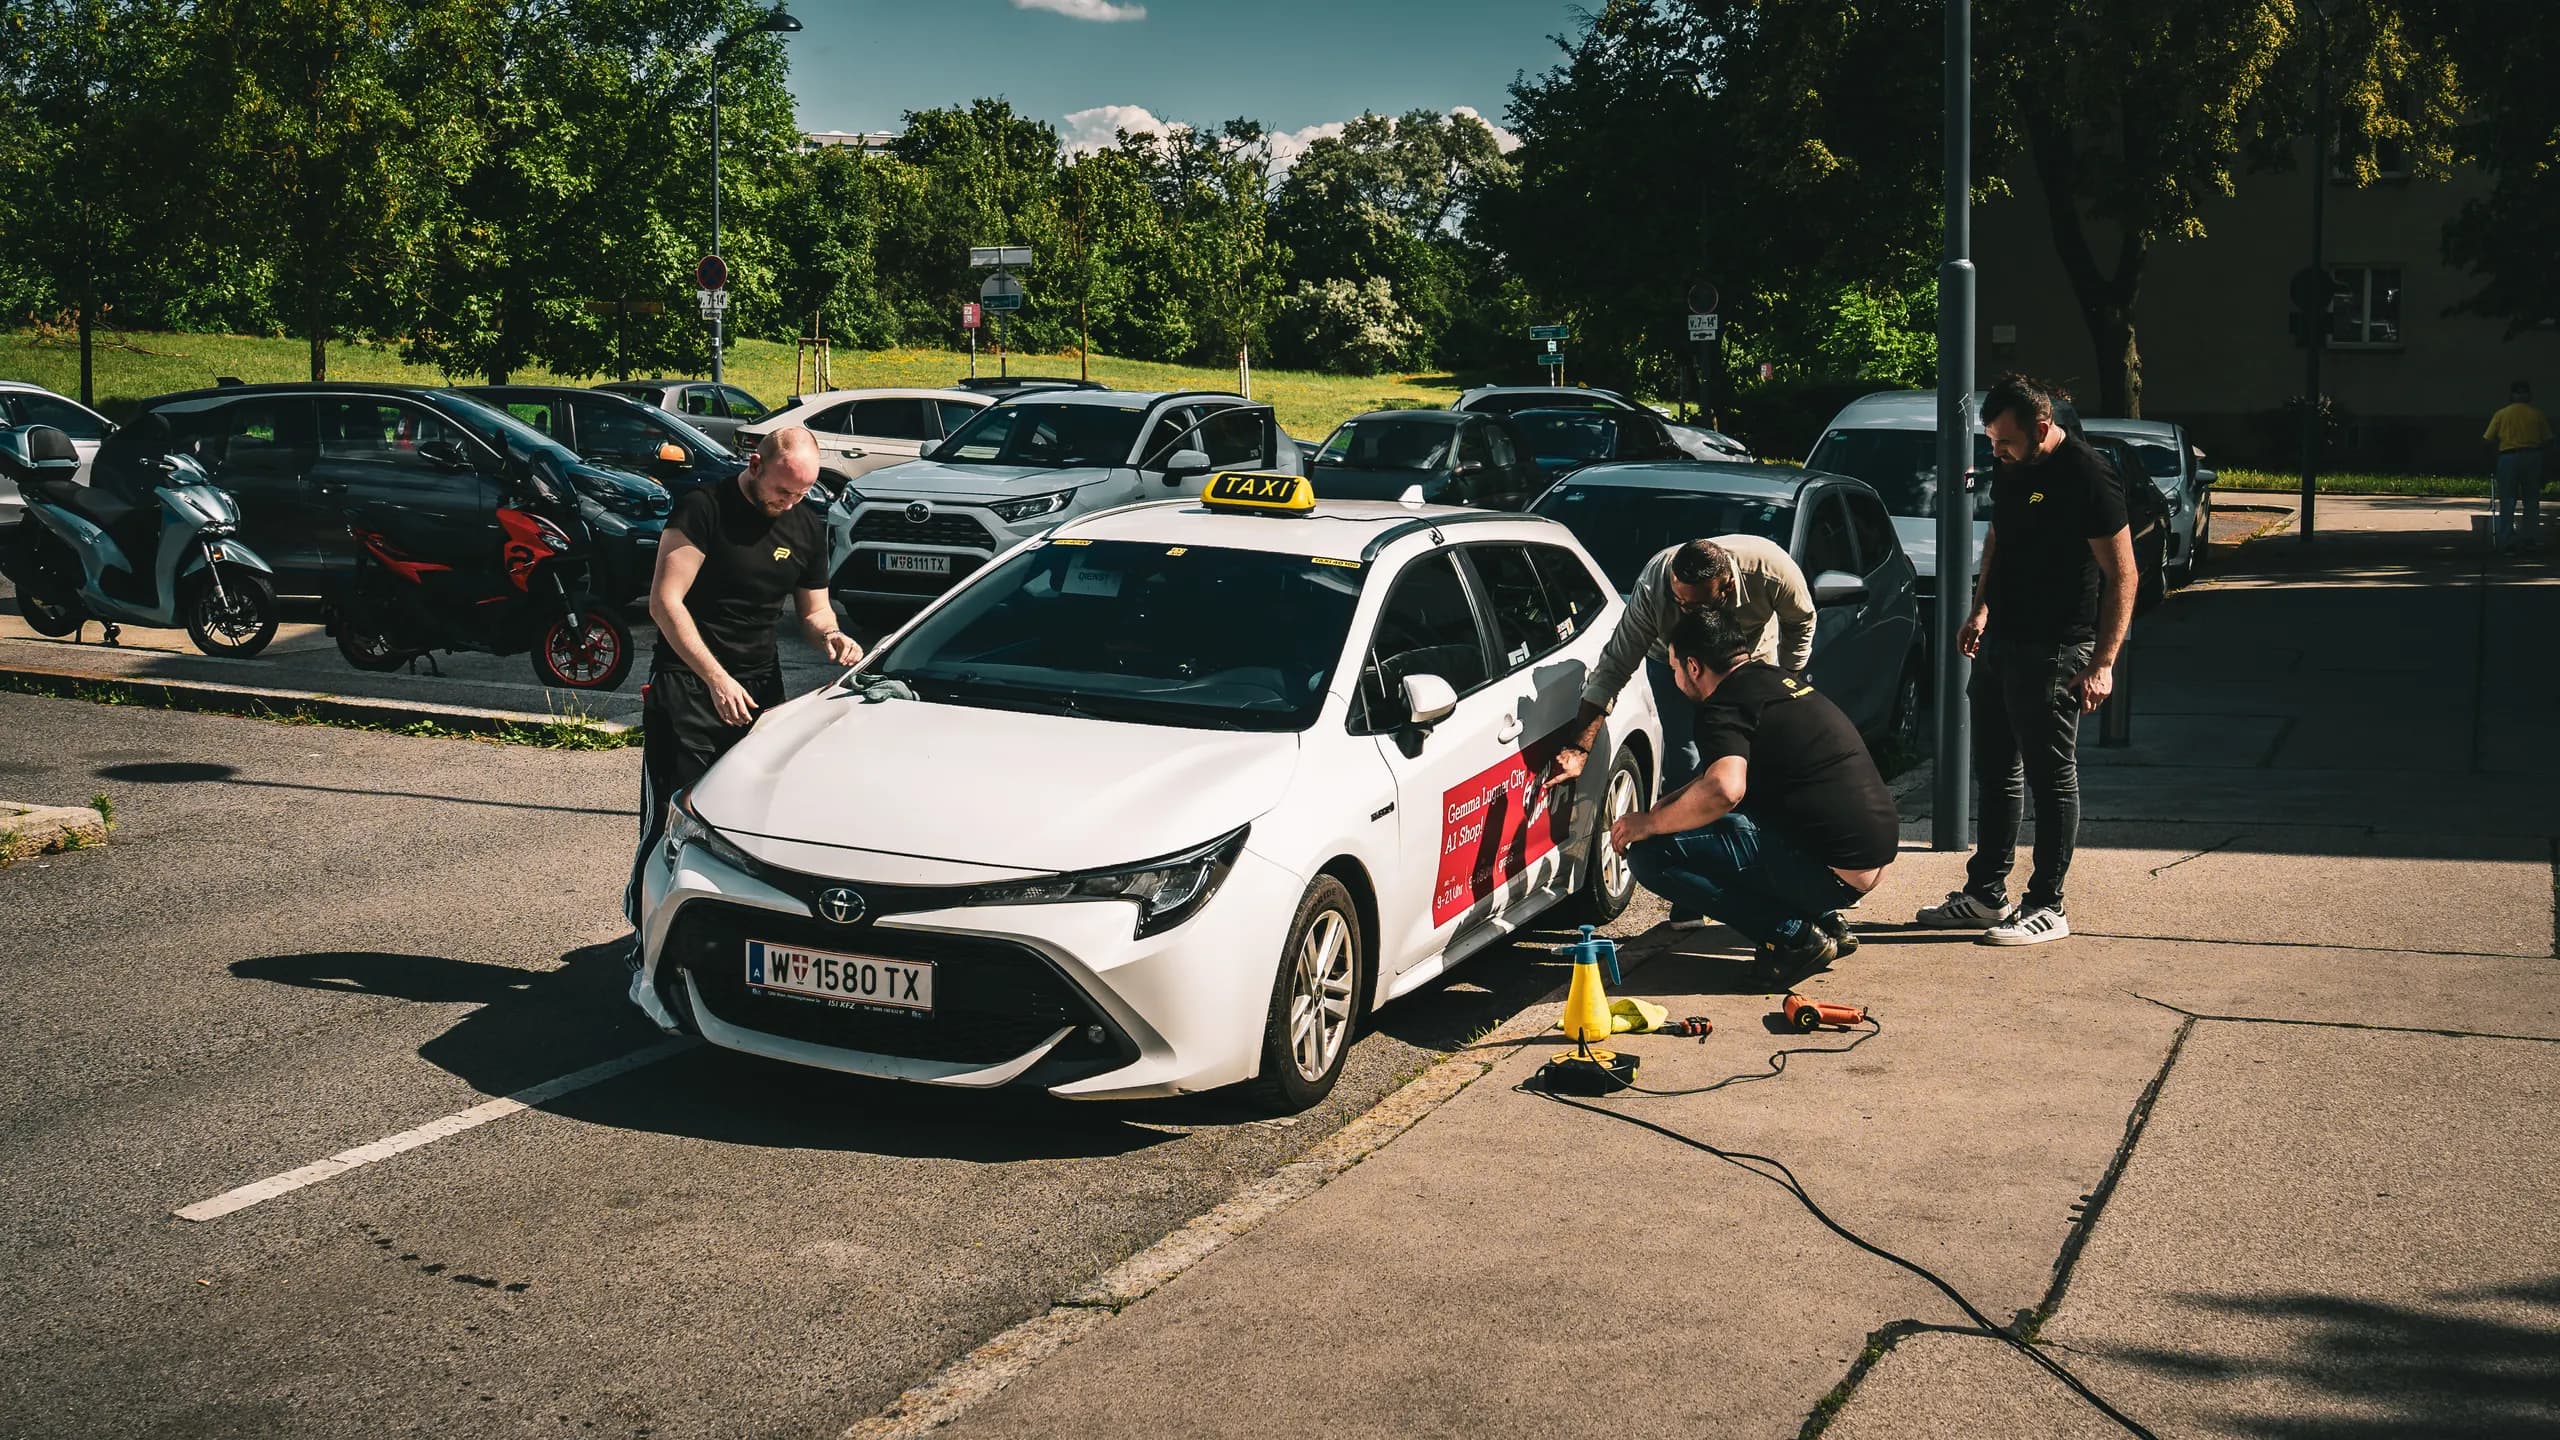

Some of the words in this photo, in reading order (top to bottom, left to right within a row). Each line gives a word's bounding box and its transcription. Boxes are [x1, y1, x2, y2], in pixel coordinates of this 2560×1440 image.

[1225, 477, 1290, 497] TAXI
[890, 556, 898, 568] W
[907, 557, 929, 570] 8111
[931, 558, 944, 571] TX
[1448, 795, 1481, 824] Gemma
[1482, 781, 1509, 806] Lugner
[1511, 769, 1527, 789] City
[1444, 833, 1456, 855] A1
[1458, 816, 1485, 847] Shop!
[771, 951, 790, 984] W
[812, 958, 877, 996] 1580
[884, 966, 919, 1001] TX
